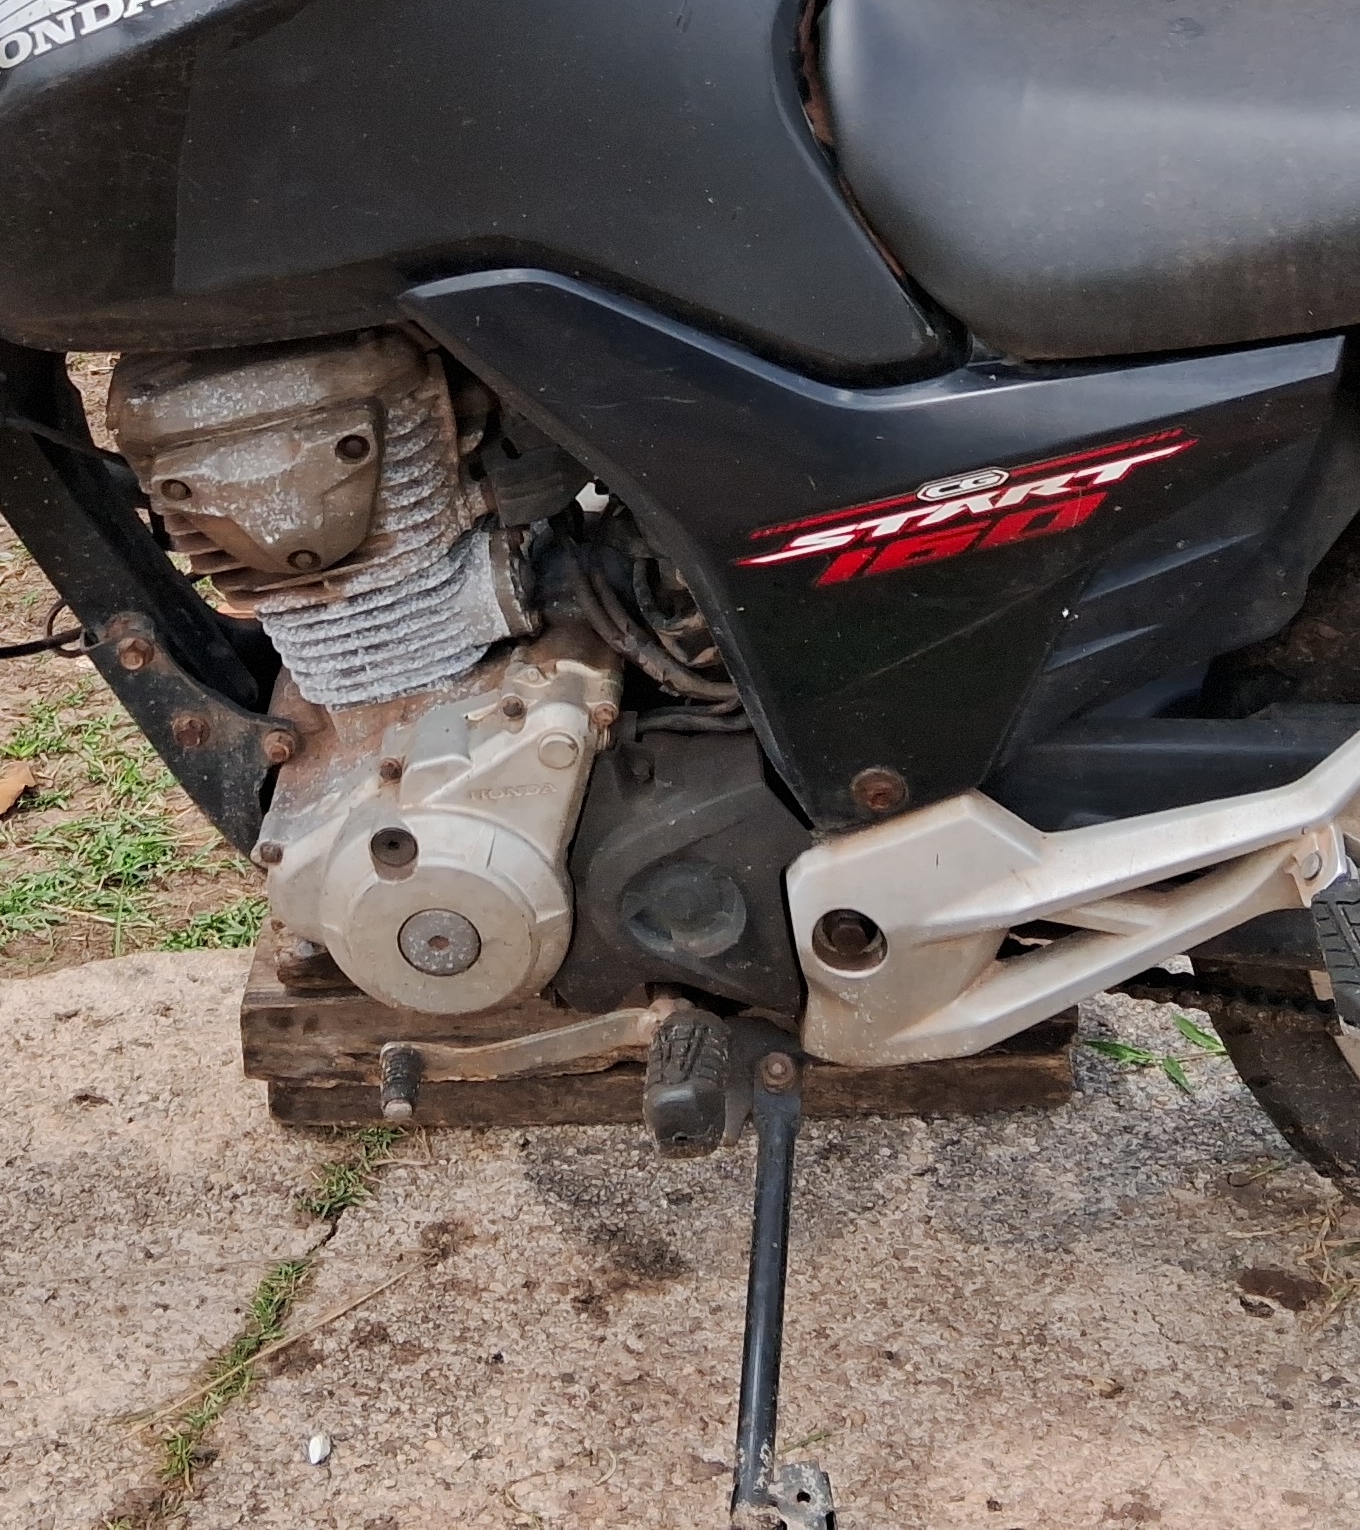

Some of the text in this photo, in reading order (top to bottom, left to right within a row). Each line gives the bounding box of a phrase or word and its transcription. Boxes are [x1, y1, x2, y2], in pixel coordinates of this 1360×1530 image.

[736, 442, 1186, 567] START
[929, 473, 996, 497] CG
[813, 491, 1108, 588] 160
[468, 781, 558, 802] HONDA
